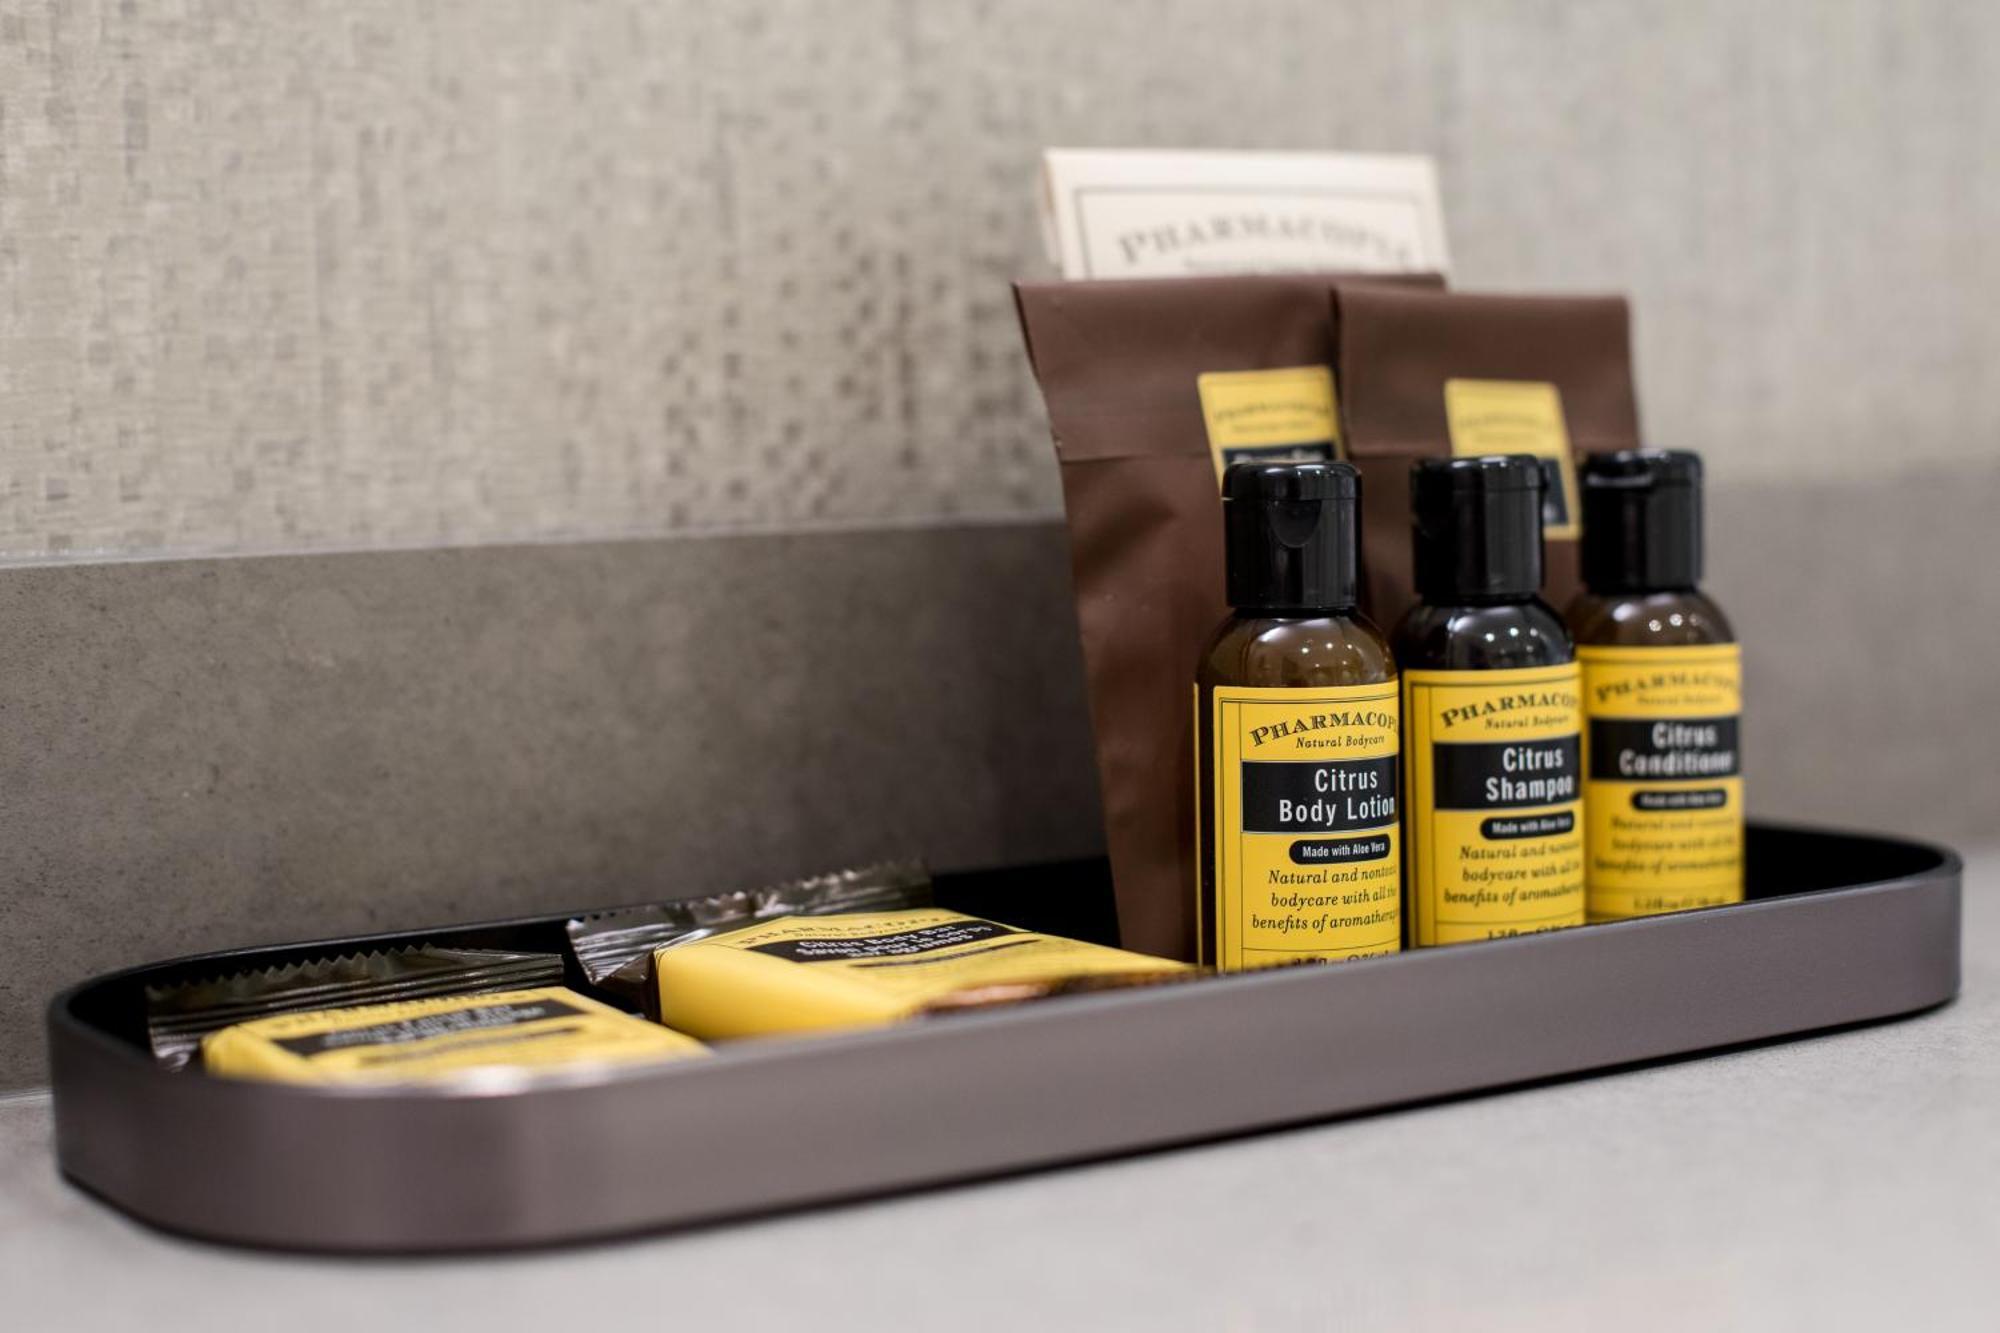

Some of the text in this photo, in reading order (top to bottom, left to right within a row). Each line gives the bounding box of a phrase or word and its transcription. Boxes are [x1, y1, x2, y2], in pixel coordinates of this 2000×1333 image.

[1296, 735, 1342, 748] Natural
[1652, 722, 1717, 748] Citrus
[1503, 747, 1563, 772] Citrus
[1314, 768, 1378, 792] Citrus
[1486, 775, 1573, 801] Shampoo
[1279, 795, 1395, 826] Body Lotion
[1492, 821, 1518, 834] Made
[1302, 845, 1329, 857] Made
[1331, 844, 1351, 857] with
[1352, 843, 1370, 855] Aloe
[1460, 844, 1517, 860] Natural
[1268, 869, 1328, 885] Natural
[1331, 867, 1358, 883] and
[1463, 866, 1527, 886] bodycare
[1271, 891, 1338, 911] bodycare
[1342, 888, 1370, 905] with
[1372, 885, 1386, 901] all
[1444, 887, 1499, 908] benefits
[1502, 886, 1518, 906] of
[1252, 913, 1308, 934] benefits
[1312, 913, 1329, 934] of
